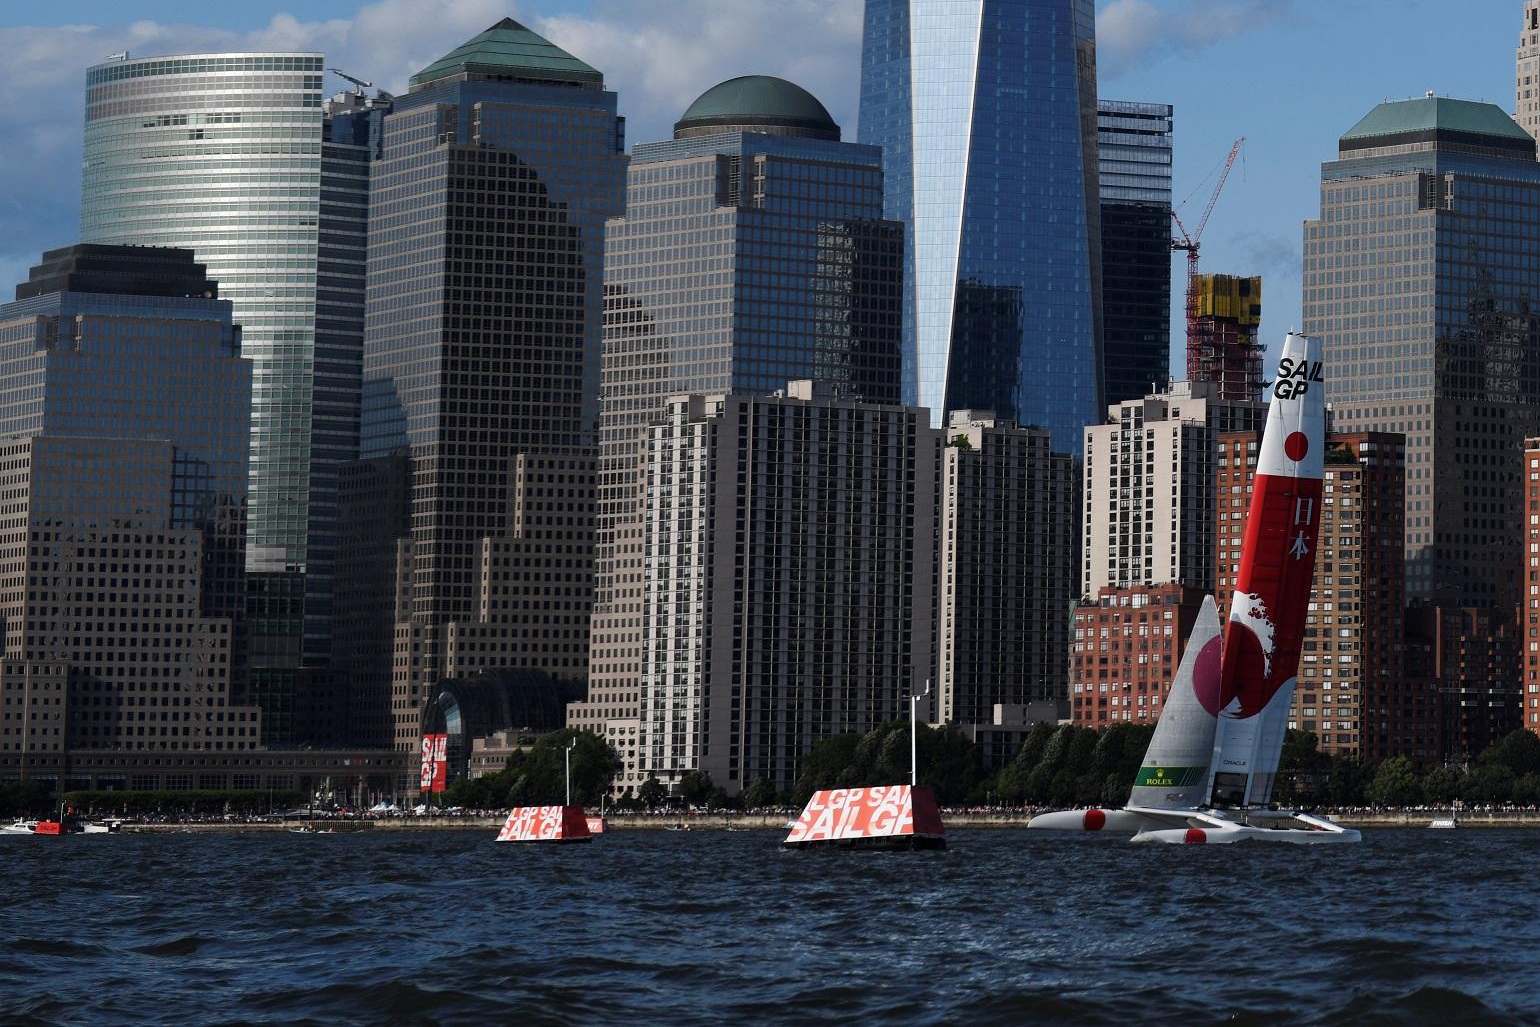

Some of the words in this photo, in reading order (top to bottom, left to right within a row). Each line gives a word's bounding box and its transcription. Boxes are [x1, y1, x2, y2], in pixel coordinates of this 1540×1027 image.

[1277, 357, 1324, 383] SAIL
[1273, 380, 1309, 400] GP
[1288, 496, 1313, 560] 日本
[421, 737, 447, 762] SAIL
[420, 762, 438, 787] GP
[786, 805, 865, 842] SAIL
